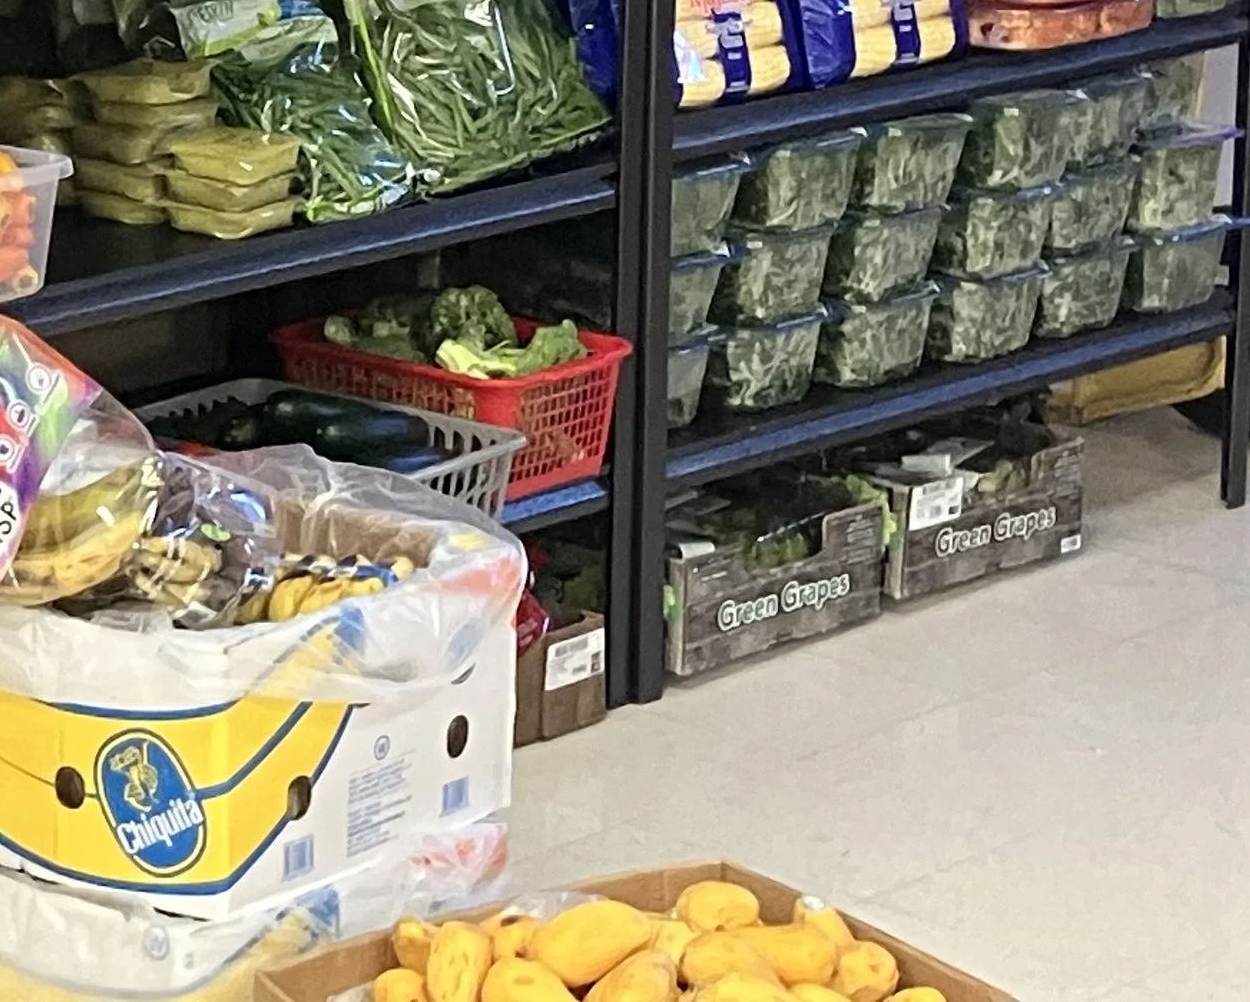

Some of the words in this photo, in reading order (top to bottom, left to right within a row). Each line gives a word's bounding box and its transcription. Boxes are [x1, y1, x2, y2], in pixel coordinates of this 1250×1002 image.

[935, 524, 991, 557] Green
[993, 506, 1056, 542] Grapes
[717, 594, 778, 631] Green
[781, 573, 850, 610] Grapes
[117, 797, 203, 855] Chiquita
